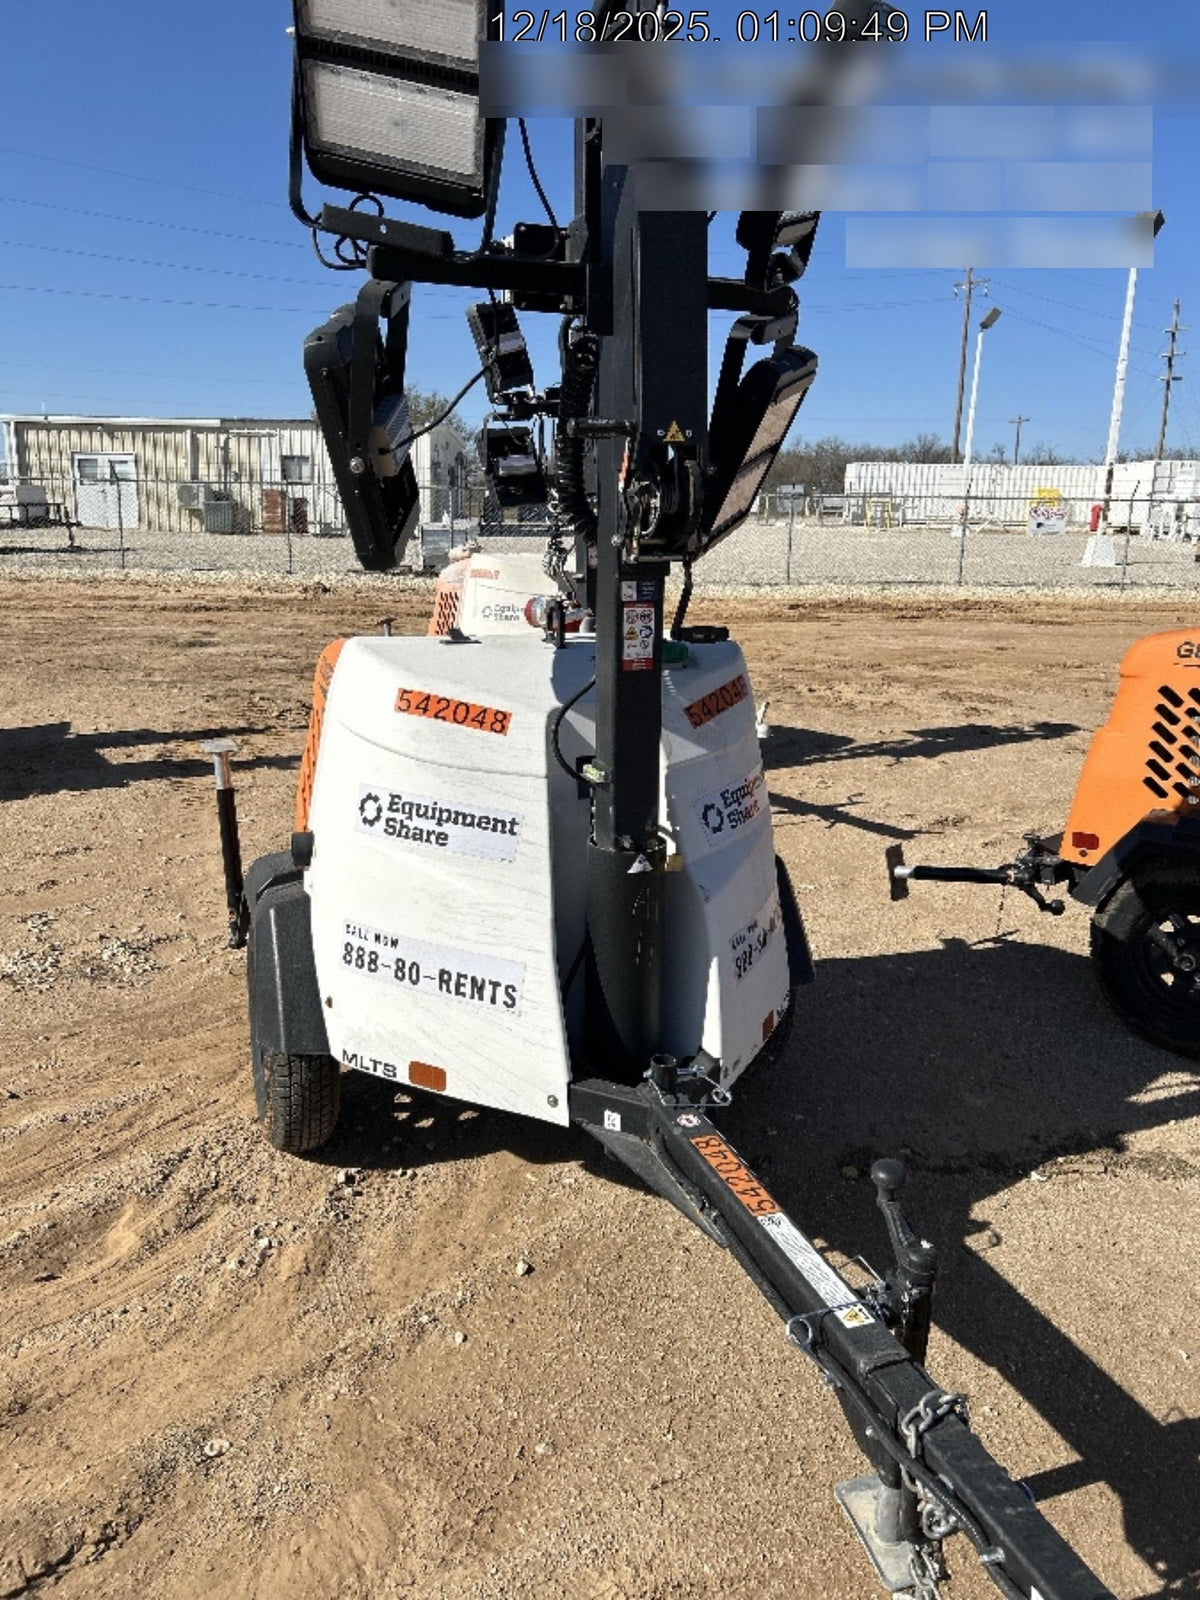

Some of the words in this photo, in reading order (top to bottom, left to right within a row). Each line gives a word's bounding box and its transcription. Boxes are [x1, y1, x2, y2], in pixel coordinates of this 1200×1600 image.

[397, 689, 508, 734] 542048
[383, 817, 450, 847] Share
[387, 793, 520, 836] Equipment
[342, 941, 518, 1009] 888-80-RENTS
[342, 1048, 398, 1079] MLTS
[694, 1136, 779, 1217] 542048
